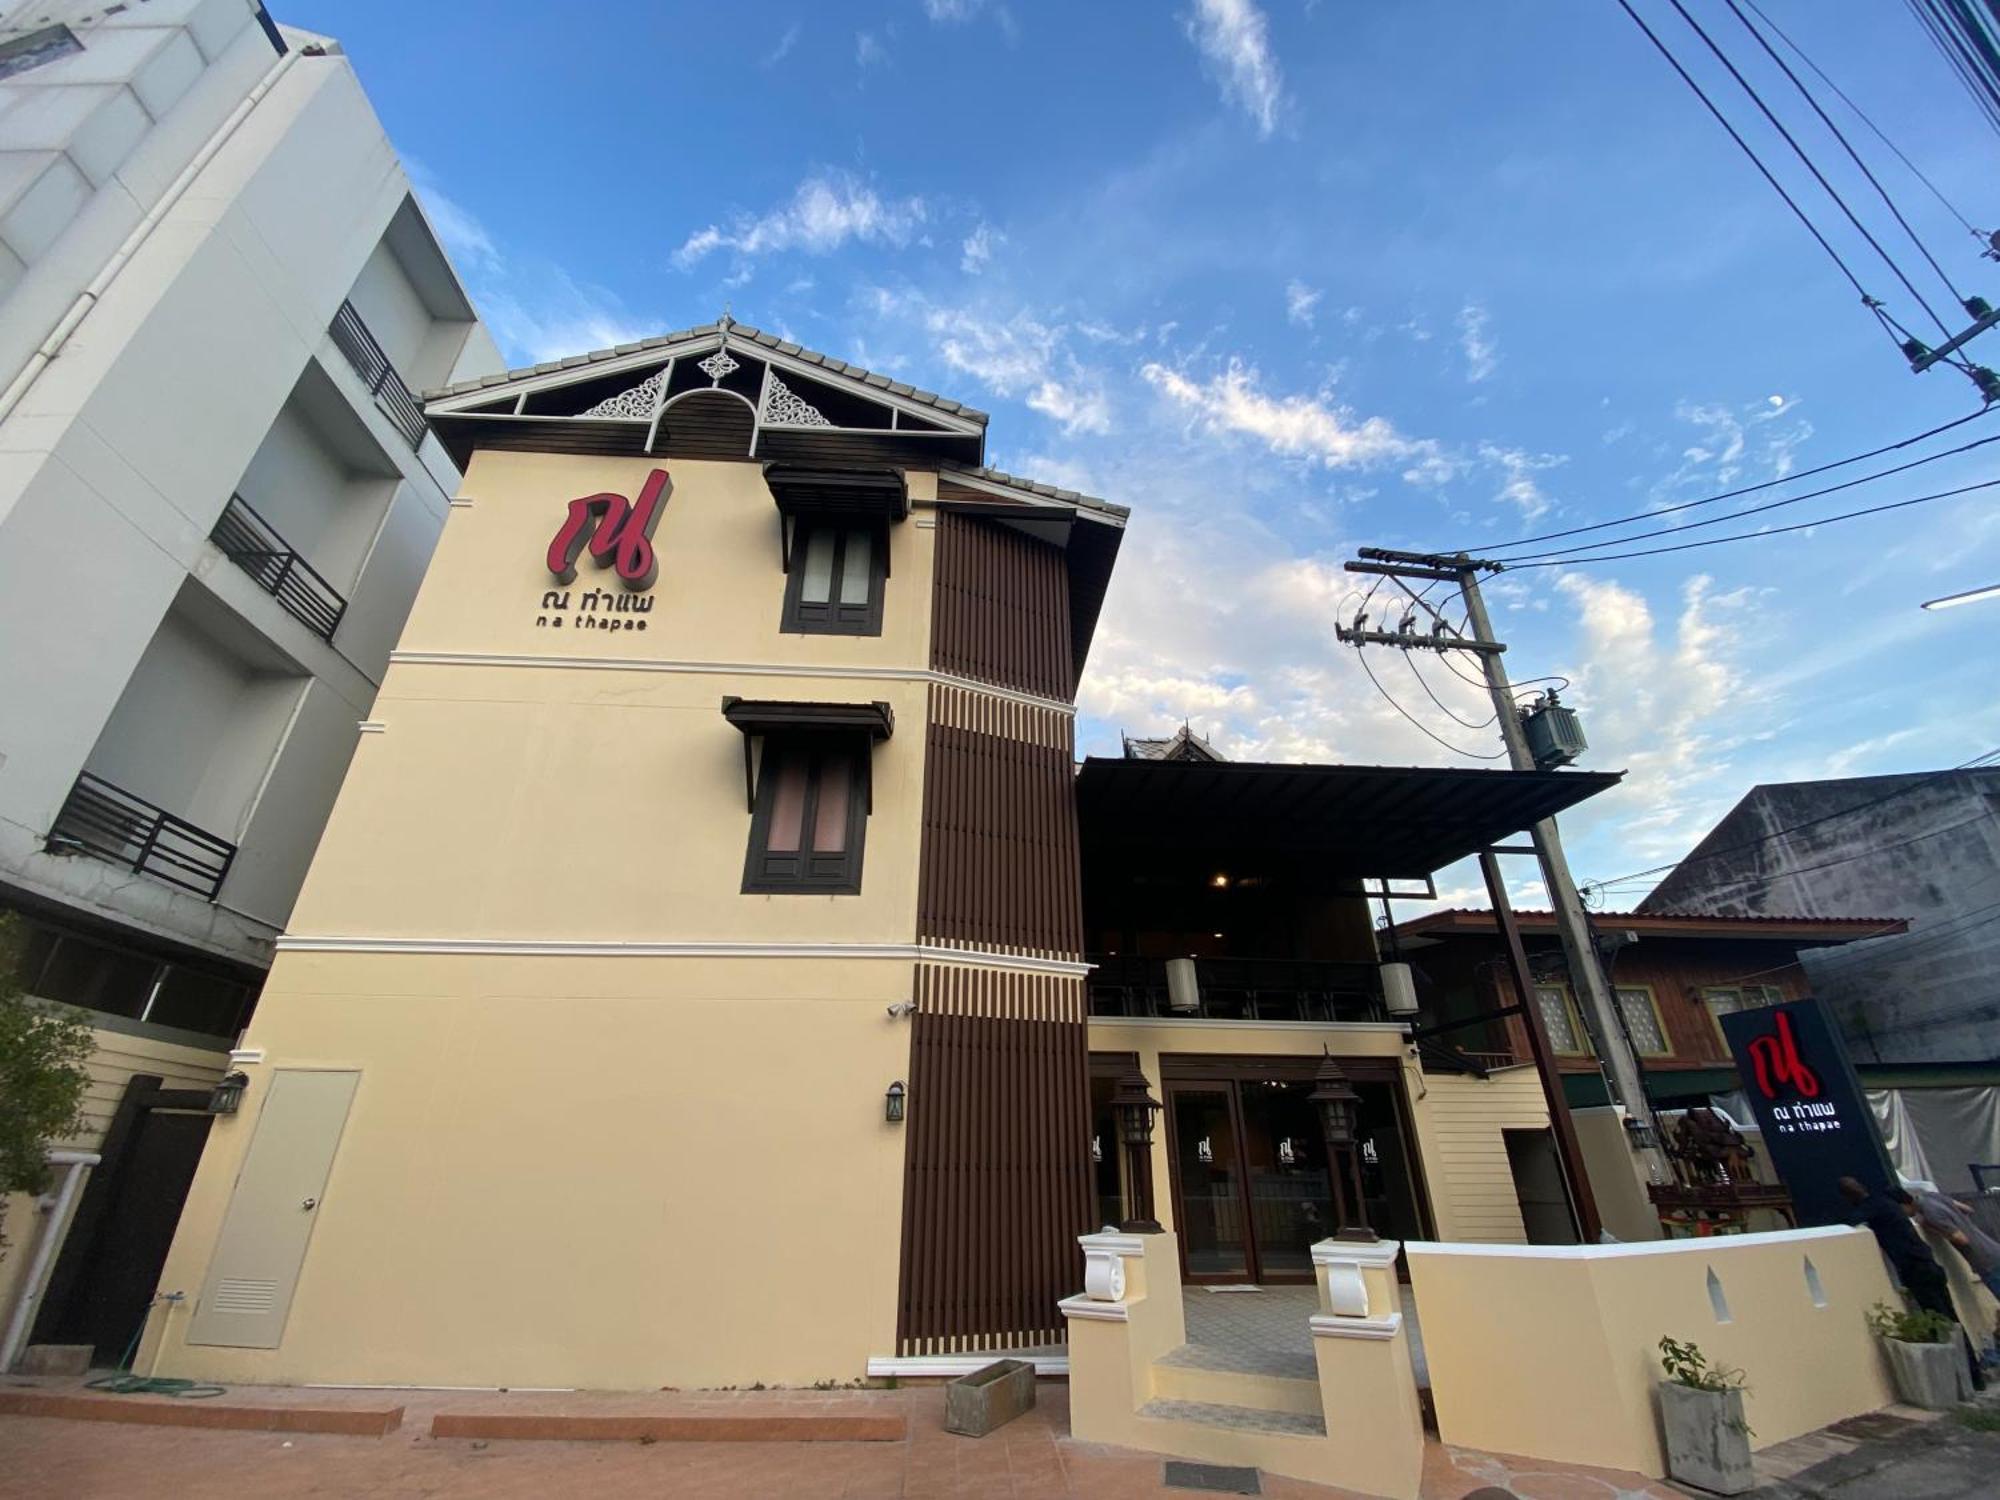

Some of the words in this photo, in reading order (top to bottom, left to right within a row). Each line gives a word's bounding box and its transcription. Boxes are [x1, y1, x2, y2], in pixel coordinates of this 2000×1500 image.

[542, 591, 570, 610] ณ
[581, 587, 655, 613] ท่าแพ
[536, 615, 563, 628] na
[575, 614, 647, 632] thapae
[1773, 1107, 1791, 1120] ณ
[1792, 1101, 1836, 1119] ท่าแพ
[1779, 1124, 1795, 1133] na
[1798, 1120, 1841, 1132] thapae
